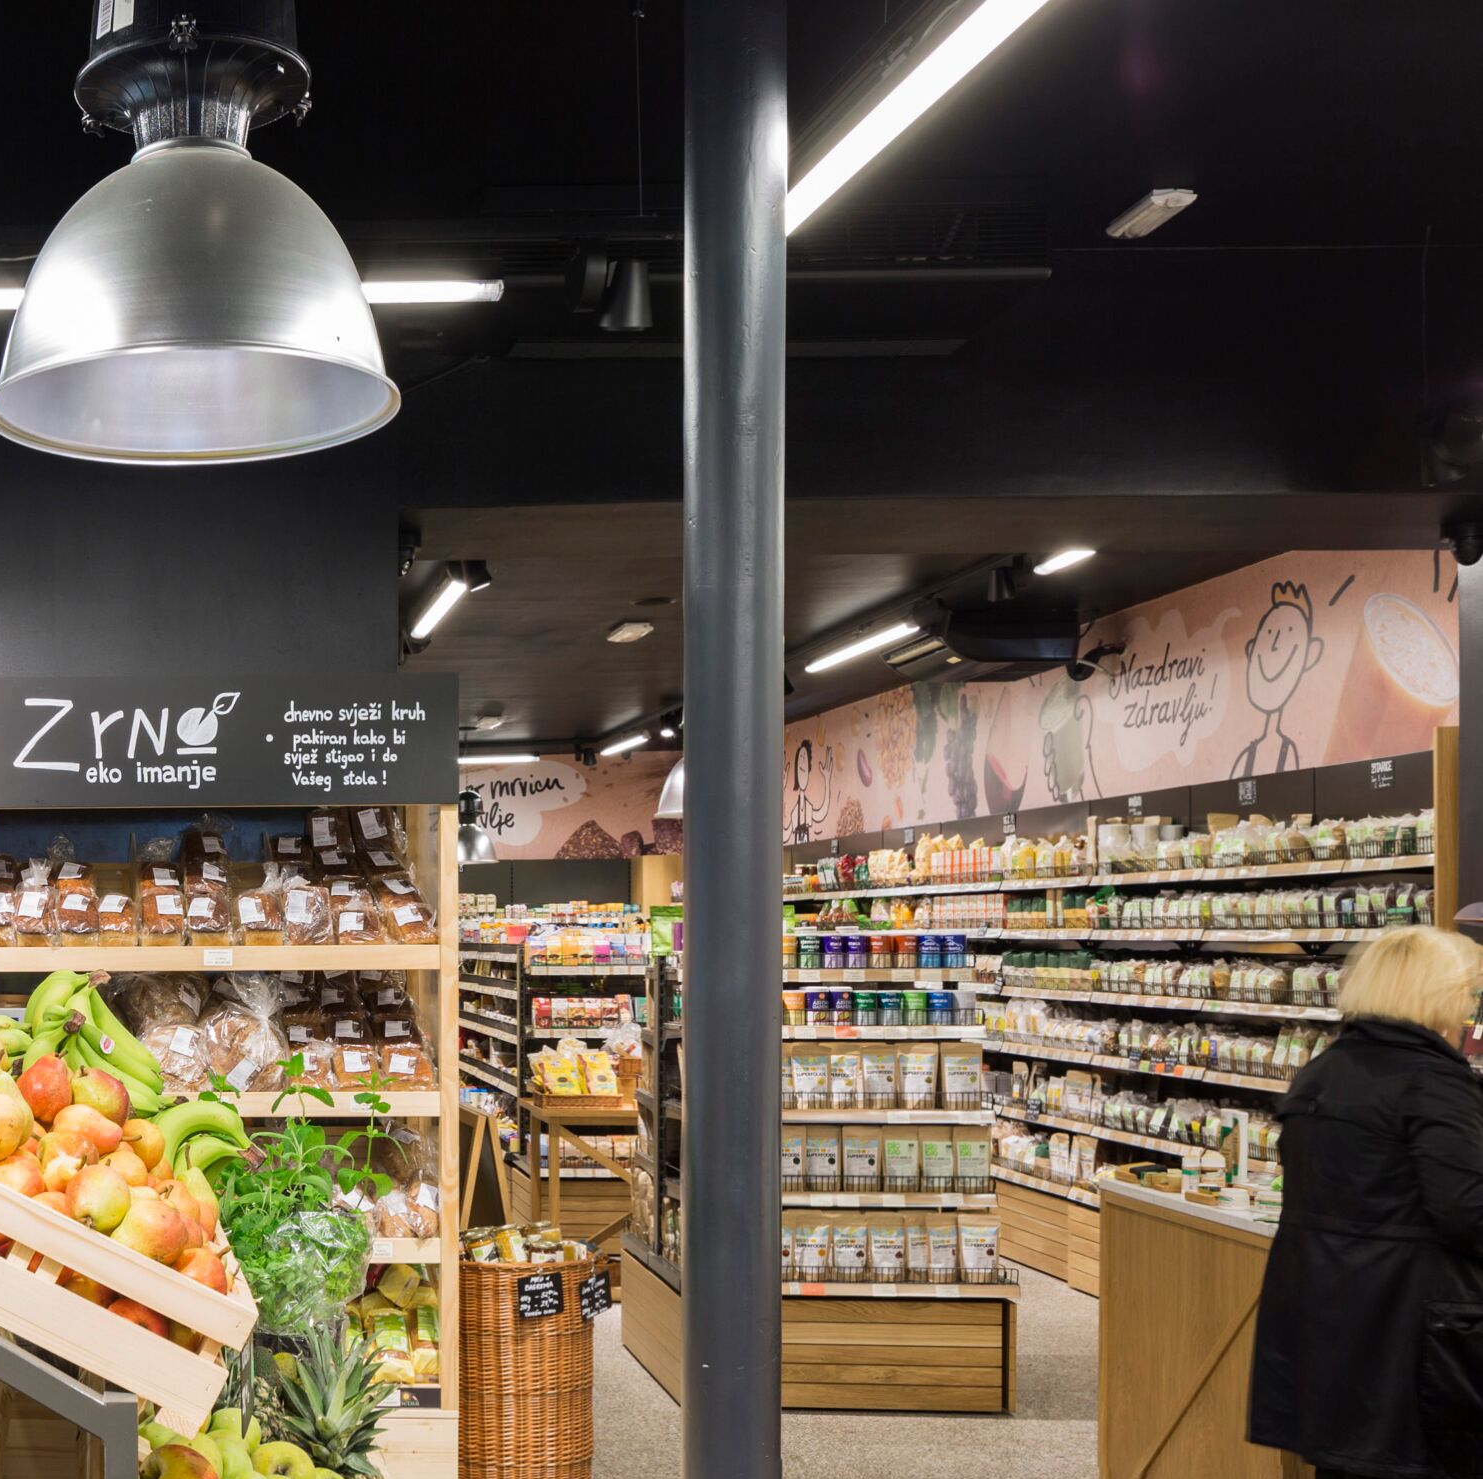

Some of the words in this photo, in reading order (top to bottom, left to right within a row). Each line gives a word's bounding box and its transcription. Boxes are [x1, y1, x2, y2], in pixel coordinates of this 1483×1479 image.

[1109, 642, 1206, 700] Nazdravi
[284, 701, 333, 723] dnevno
[338, 701, 382, 727] svježi
[392, 701, 426, 722] kruh
[292, 728, 347, 752] pakiran
[353, 728, 386, 746] kako
[393, 728, 406, 745] bi
[284, 748, 318, 769] svjež
[325, 747, 365, 769] stigao
[382, 748, 398, 763] do
[85, 762, 122, 784] eko
[136, 760, 217, 789] imanje
[292, 770, 332, 792] Vašeg
[490, 774, 564, 800] mrvicu
